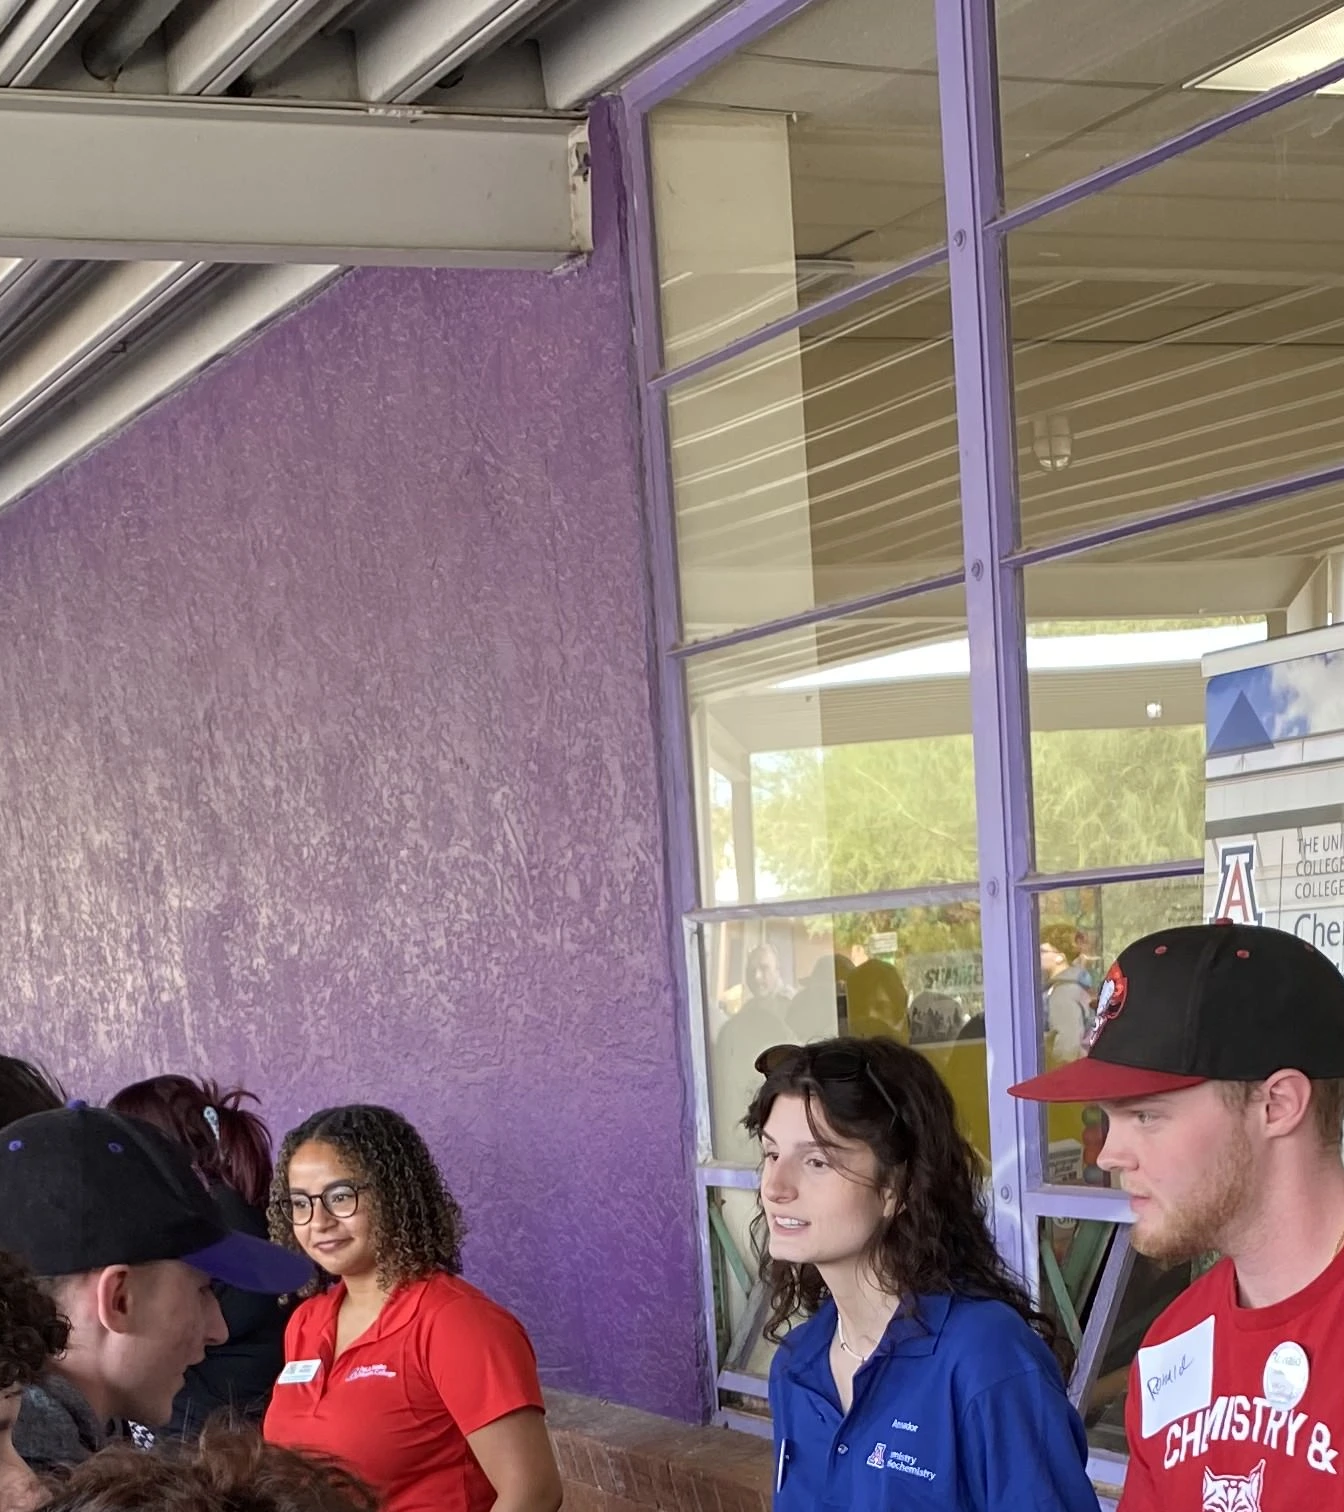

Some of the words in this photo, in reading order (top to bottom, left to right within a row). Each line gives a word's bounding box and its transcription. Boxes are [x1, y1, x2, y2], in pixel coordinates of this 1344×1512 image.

[1298, 836, 1319, 854] THE
[1295, 878, 1344, 899] COLLEGE
[1306, 1422, 1339, 1475] &
